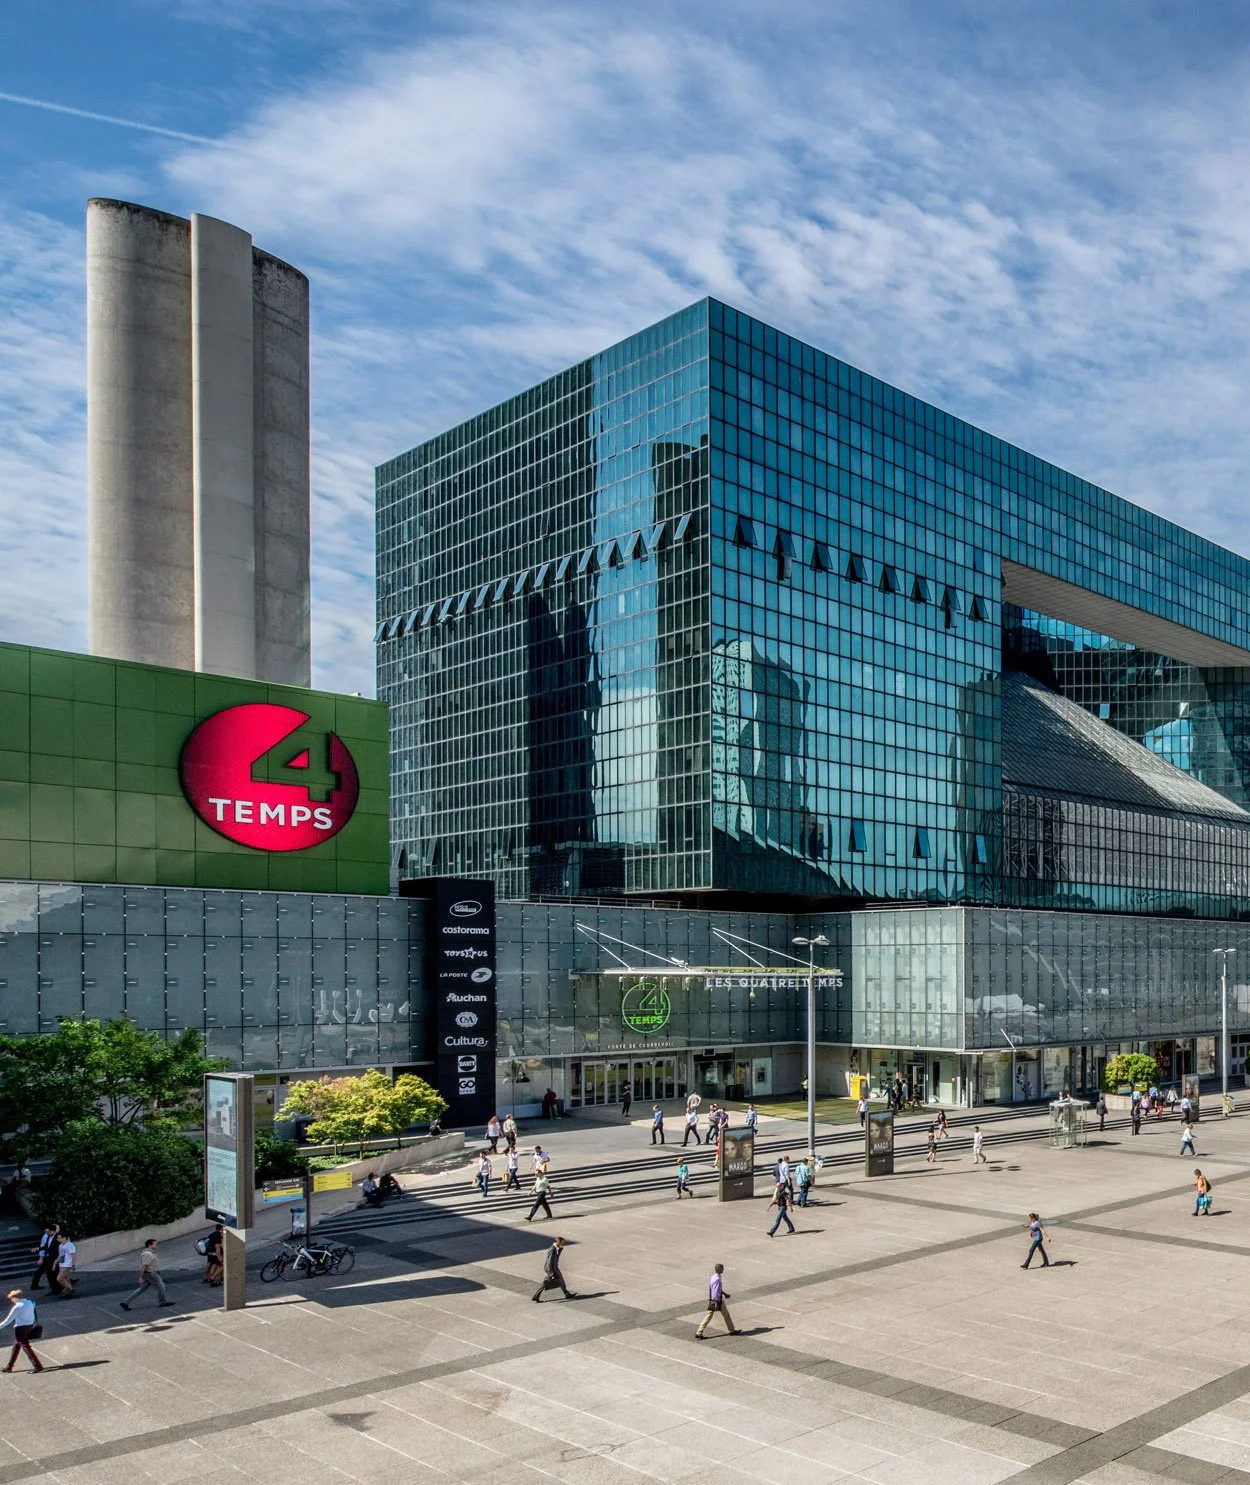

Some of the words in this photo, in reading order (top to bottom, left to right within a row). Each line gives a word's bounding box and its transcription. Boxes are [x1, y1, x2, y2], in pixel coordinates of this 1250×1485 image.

[250, 713, 342, 803] 4
[208, 797, 333, 830] TEMPS
[442, 926, 490, 935] castorama
[706, 978, 731, 987] LES
[739, 977, 795, 988] QUATRE
[801, 977, 843, 988] TMPS
[446, 992, 487, 1003] Auchan
[640, 985, 665, 1015] 4
[459, 1016, 474, 1024] C&A
[629, 1015, 663, 1025] TEMPS
[444, 1036, 488, 1047] Cultura
[459, 1080, 475, 1089] GO
